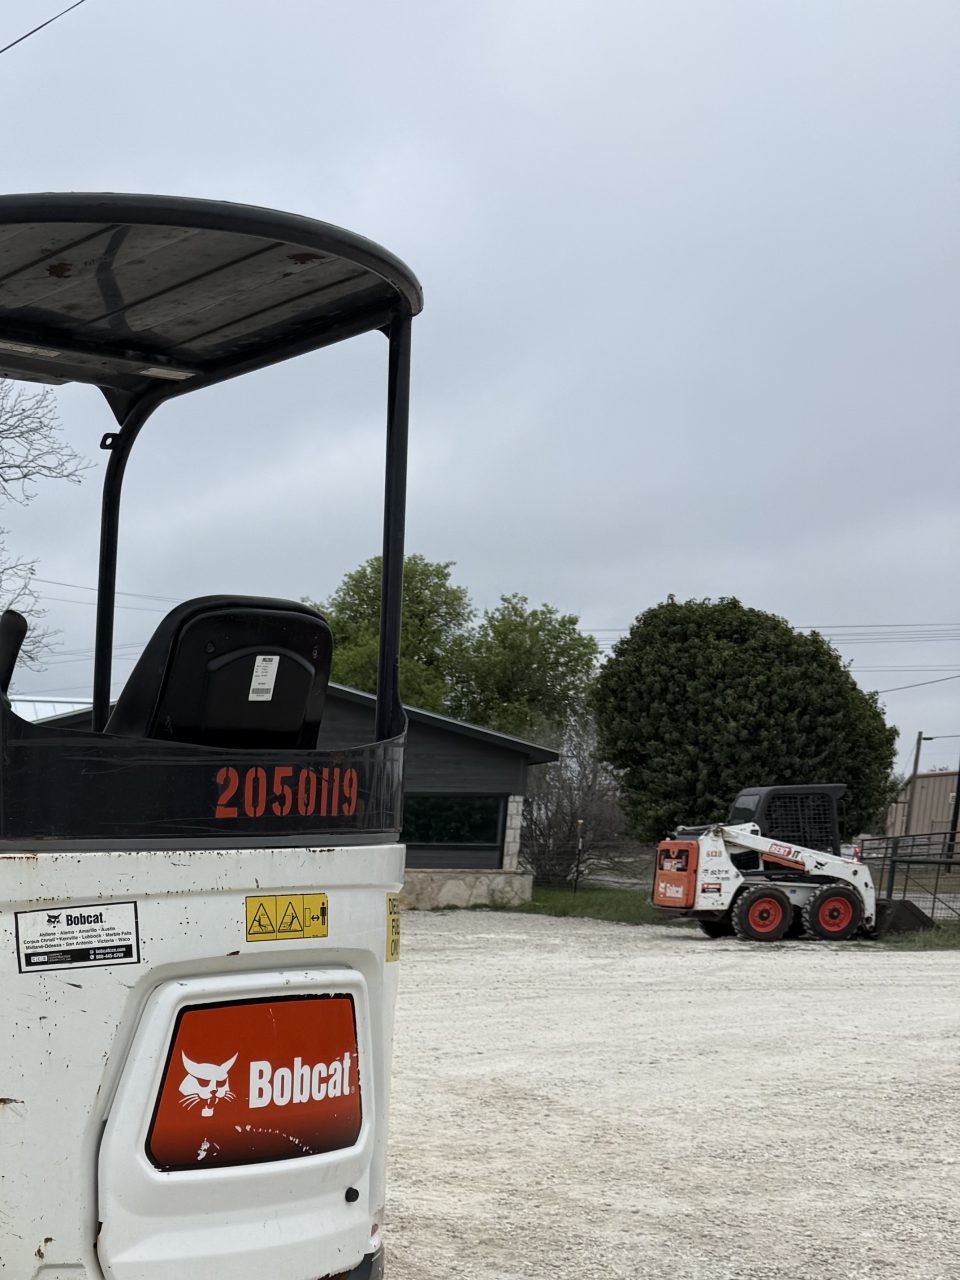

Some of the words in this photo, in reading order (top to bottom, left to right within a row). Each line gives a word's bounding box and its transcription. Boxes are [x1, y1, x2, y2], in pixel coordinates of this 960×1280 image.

[215, 766, 358, 818] 2050119
[66, 912, 104, 926] Bobcat
[249, 1051, 351, 1109] Bobcat
